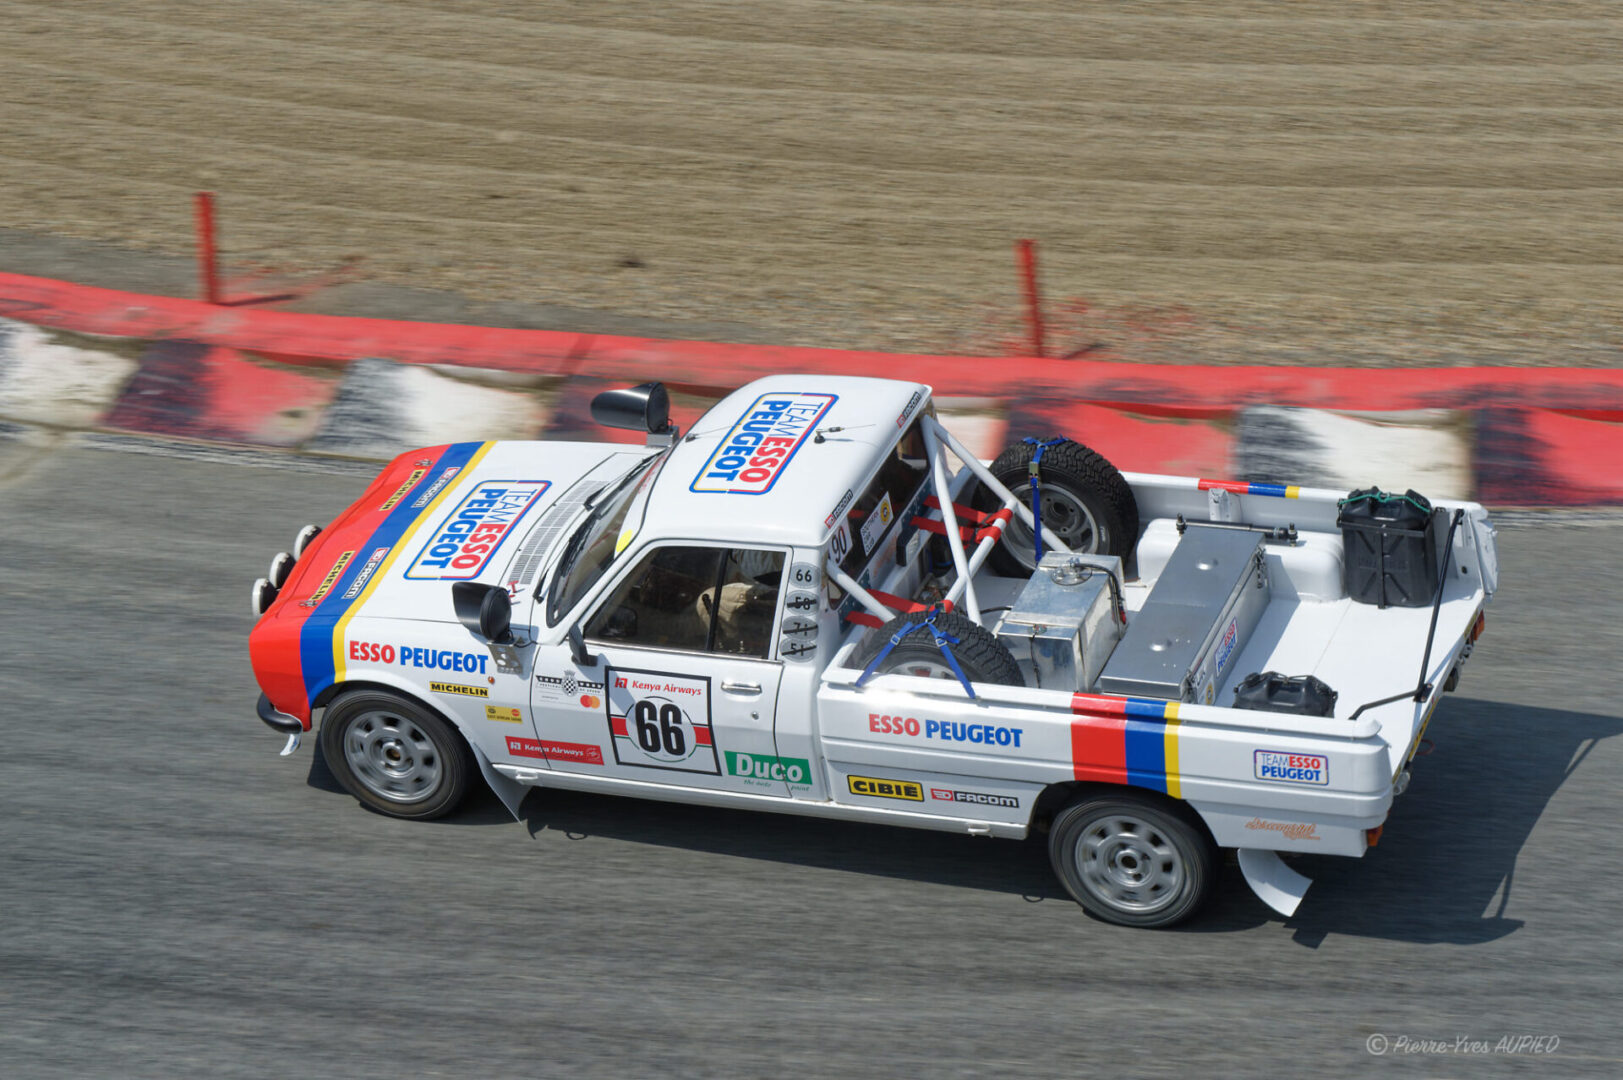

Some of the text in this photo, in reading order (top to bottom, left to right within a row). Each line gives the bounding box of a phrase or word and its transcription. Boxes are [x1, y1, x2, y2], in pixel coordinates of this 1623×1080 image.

[707, 400, 792, 482] PEUGEOT
[739, 402, 824, 482] TEAM ESSO
[382, 471, 422, 510] MICHELIN
[420, 488, 508, 568] PEUGEOT
[451, 489, 537, 569] TEAM ESSO
[312, 552, 352, 600] MICHELIN
[796, 569, 812, 582] 66
[350, 640, 488, 674] ESSO PEUGEOT
[430, 682, 488, 697] MICHELIN
[632, 680, 660, 692] Kenya
[663, 683, 702, 697] Airways
[635, 700, 686, 756] 66
[868, 713, 1024, 748] ESSO PEUGEOT
[524, 744, 550, 753] Kenya
[552, 746, 584, 756] Airways
[1261, 753, 1320, 770] TEAM ESSO
[736, 754, 803, 782] Duco
[1262, 765, 1321, 782] PEUGEOT
